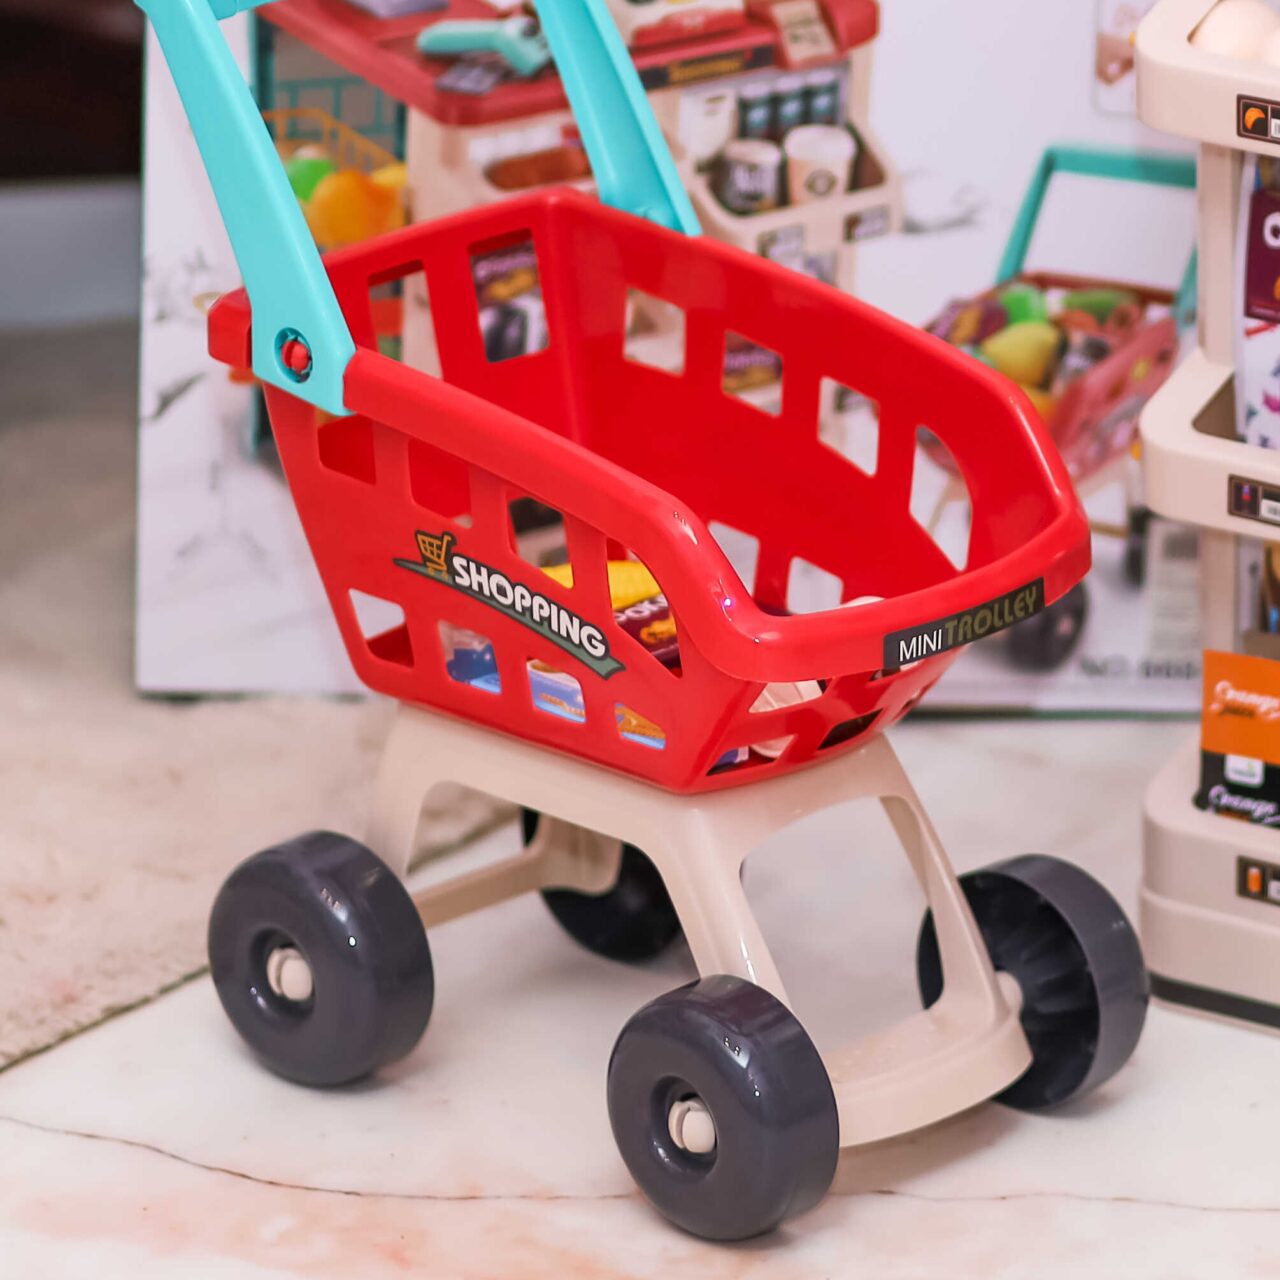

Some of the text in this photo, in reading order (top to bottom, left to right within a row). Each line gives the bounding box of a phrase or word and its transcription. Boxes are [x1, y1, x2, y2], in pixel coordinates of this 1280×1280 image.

[451, 555, 607, 657] SHOPPING
[898, 585, 1038, 662] MINI TROLLEY
